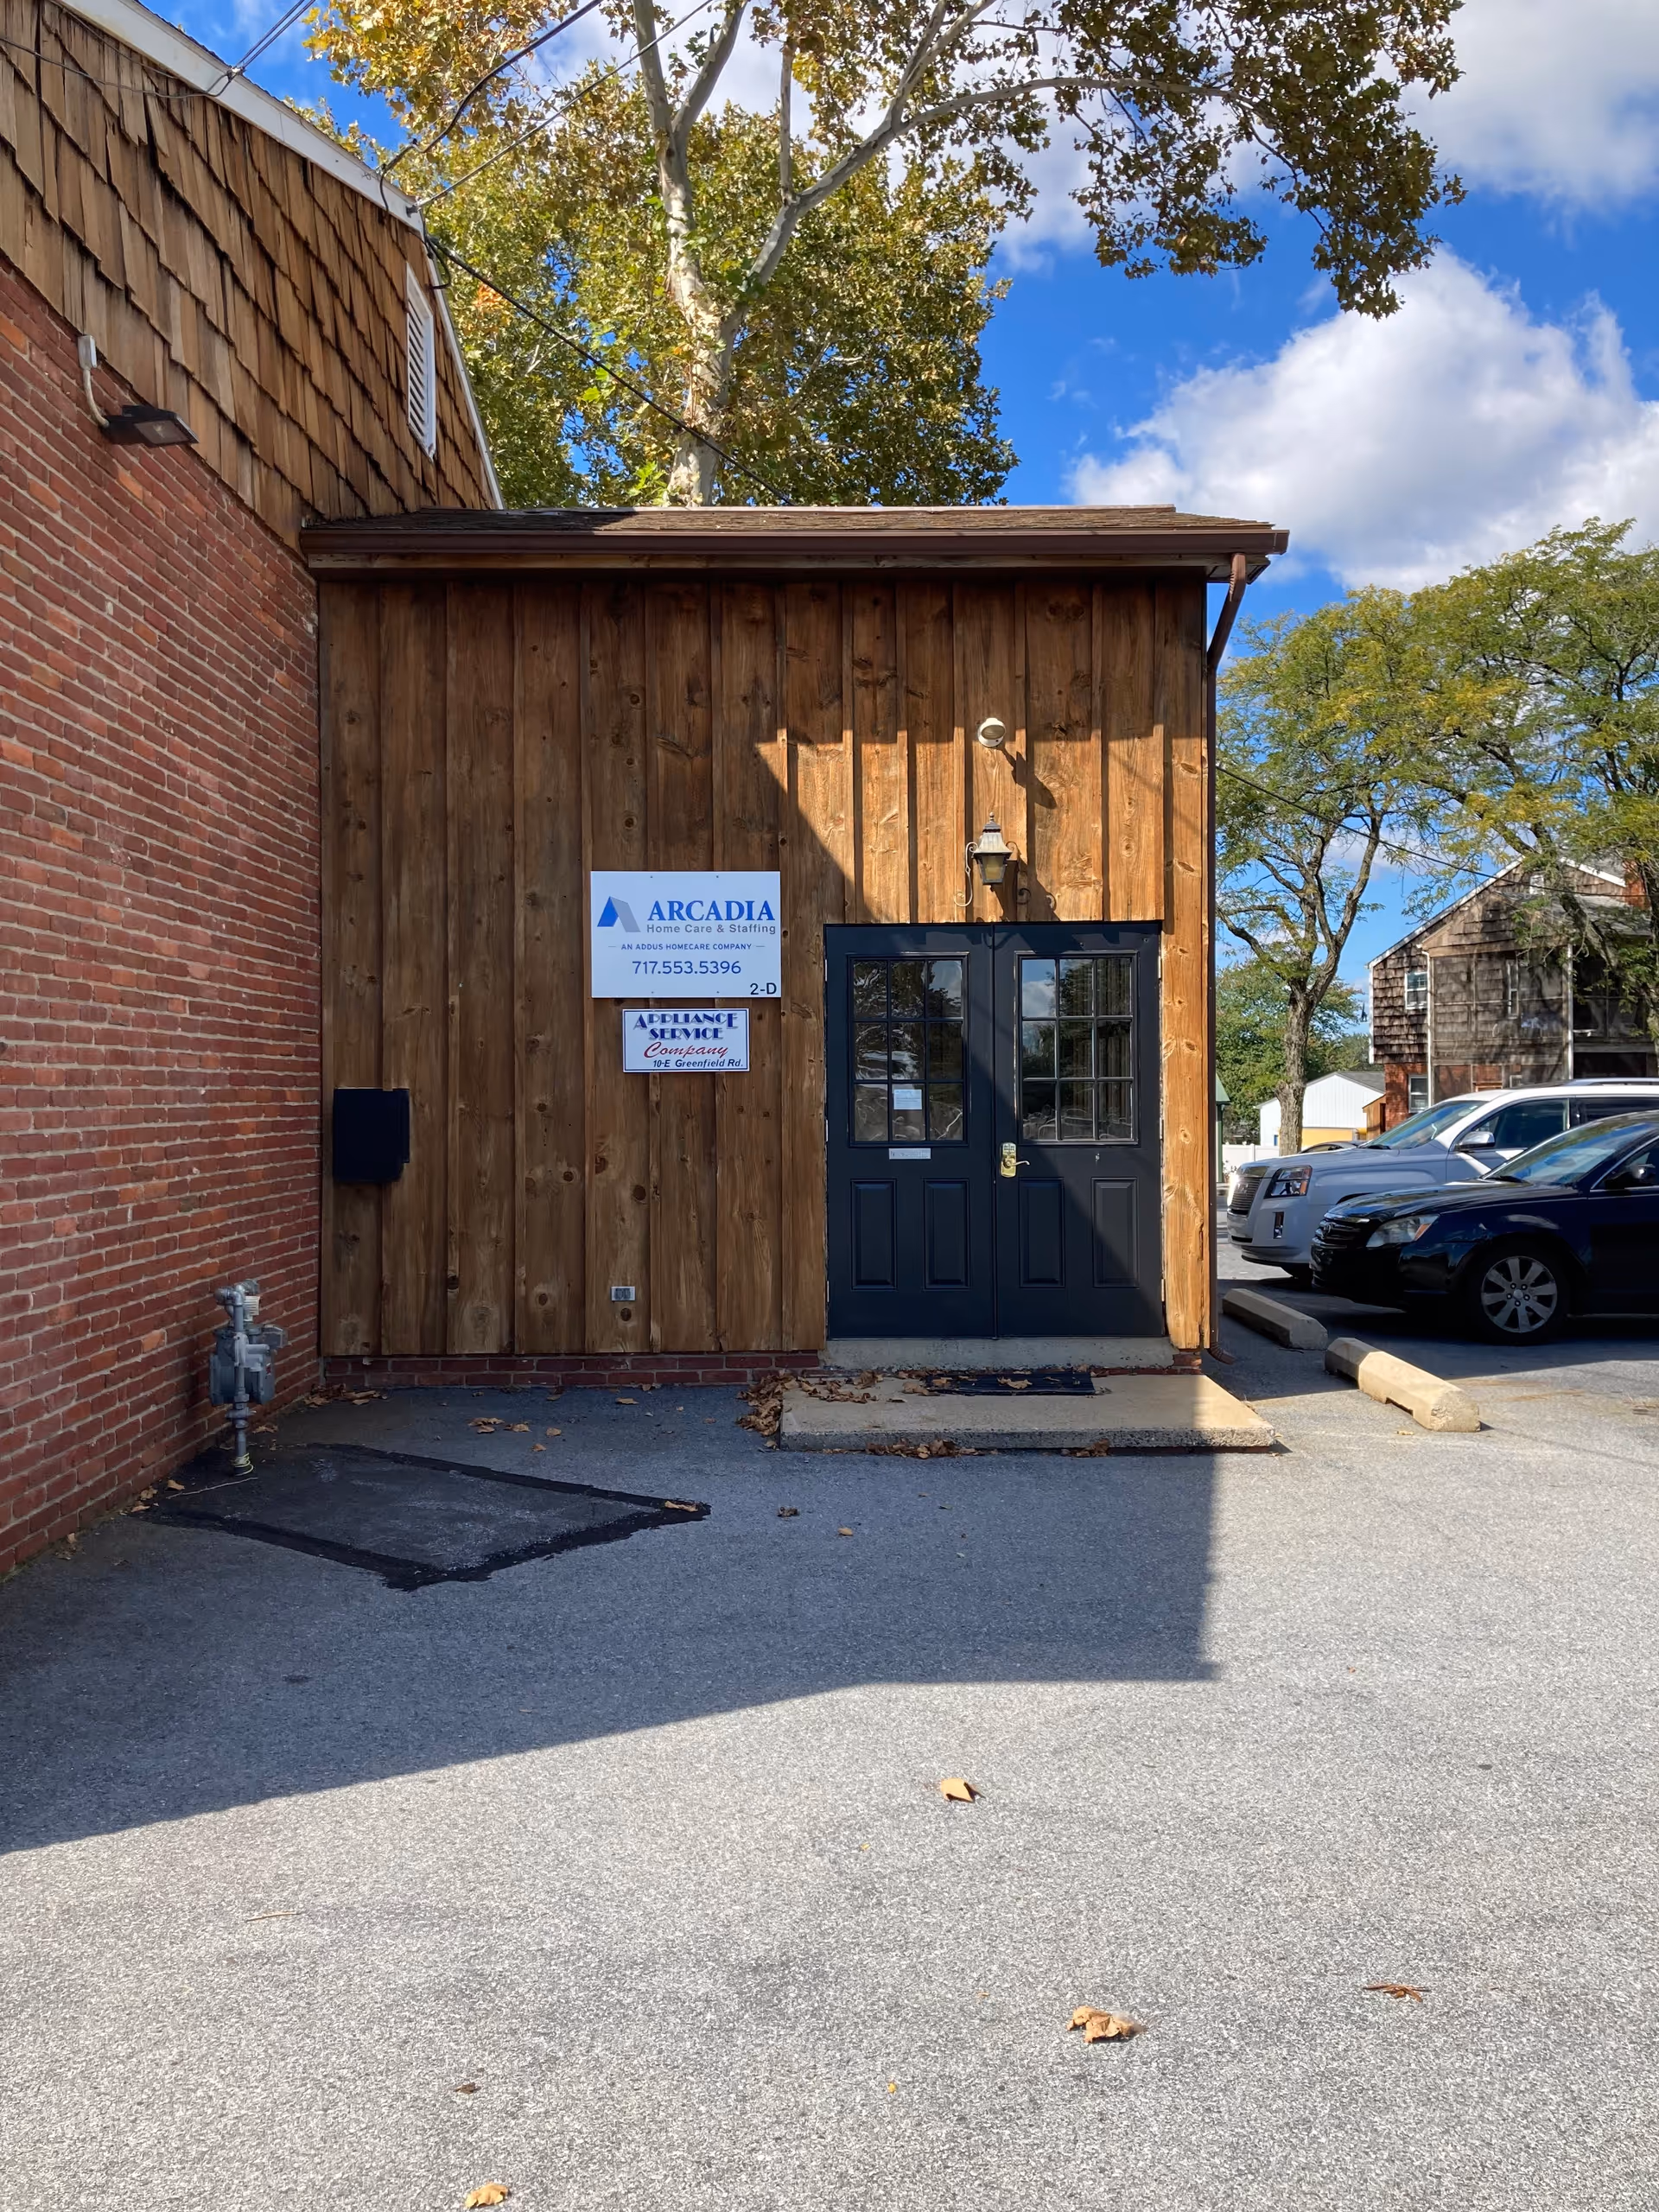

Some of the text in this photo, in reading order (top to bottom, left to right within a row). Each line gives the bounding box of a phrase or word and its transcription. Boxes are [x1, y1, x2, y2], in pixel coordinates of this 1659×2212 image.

[647, 900, 775, 921] ARCADIA
[647, 924, 776, 934] Home Care & Staffing
[632, 961, 741, 974] 717.553.5396
[750, 982, 778, 995] 2-D
[633, 1013, 738, 1030] APPLIANCE
[649, 1028, 723, 1040] SERVICE
[644, 1042, 728, 1058] Company
[653, 1058, 743, 1068] 10-E Greenfield Rd.
